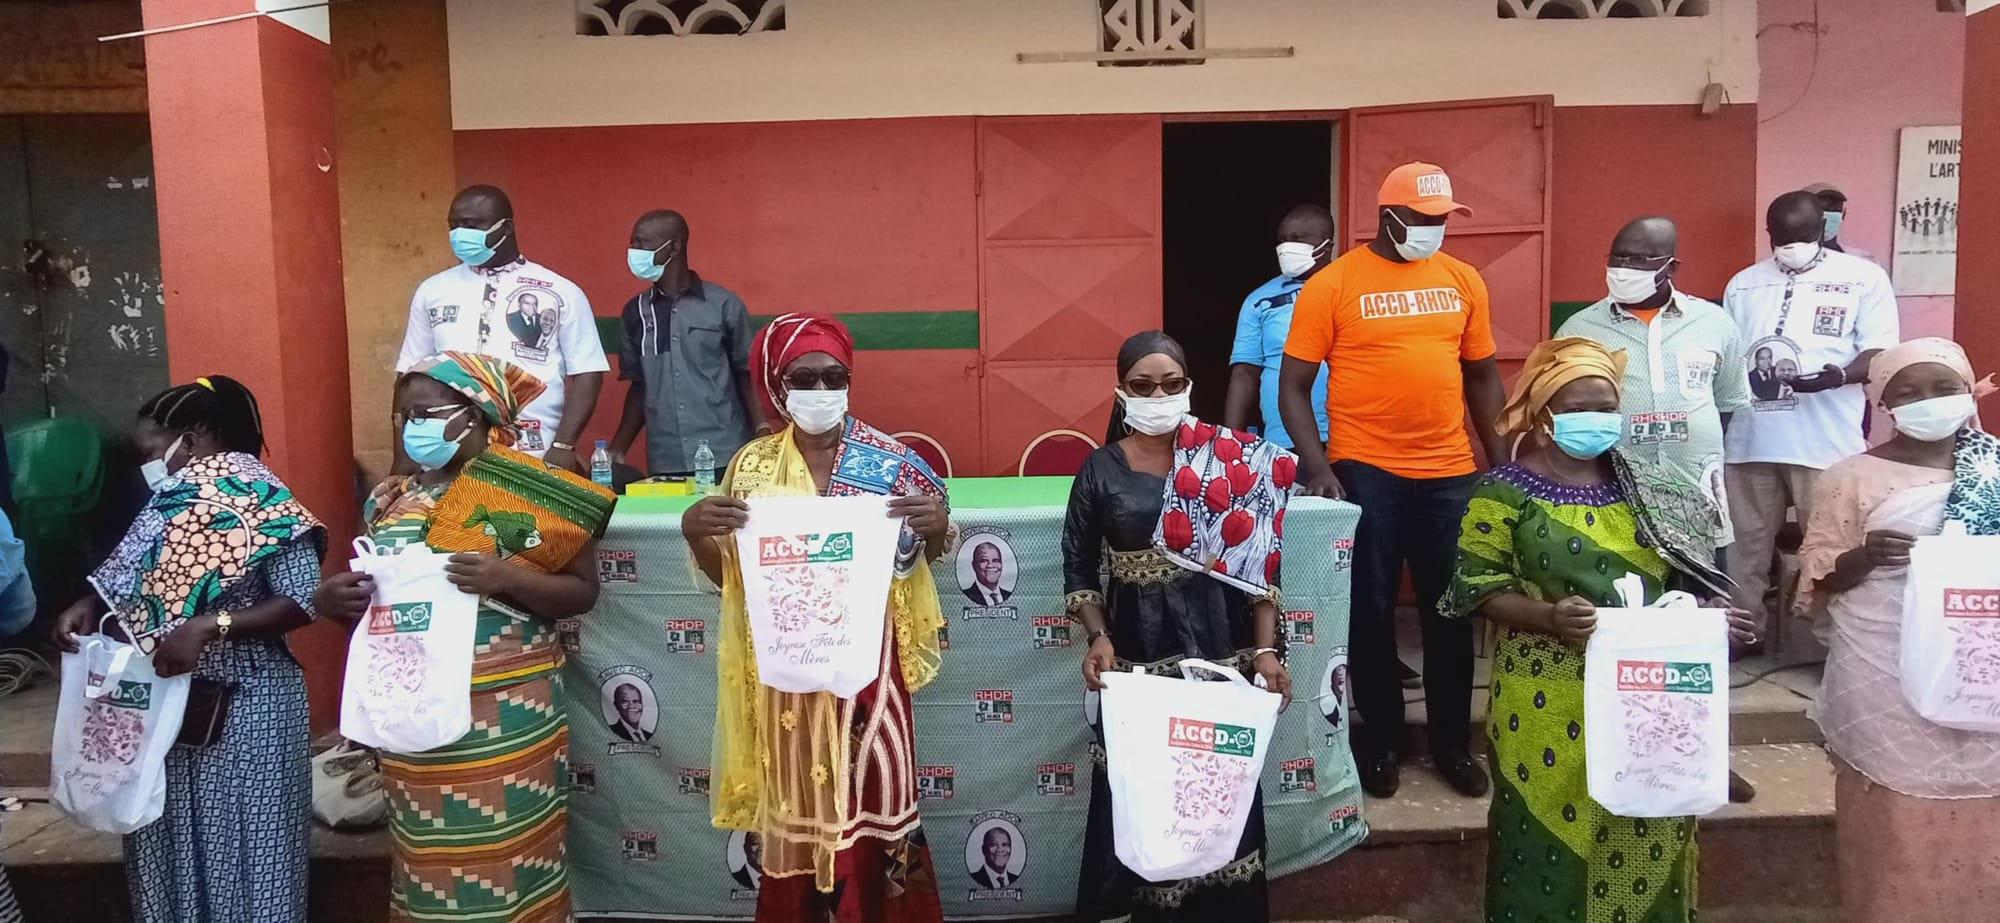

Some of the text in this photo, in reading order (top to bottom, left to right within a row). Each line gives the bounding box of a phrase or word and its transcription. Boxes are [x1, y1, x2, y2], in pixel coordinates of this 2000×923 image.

[1363, 290, 1459, 317] ACCD-RHDP
[597, 551, 635, 560] RHDP
[666, 621, 704, 630] RHDP
[1032, 616, 1071, 626] RHDP
[974, 690, 1012, 700] RHDP
[1037, 763, 1074, 774] RHDP
[1280, 758, 1314, 771] RHDP
[916, 767, 953, 776] RHDP
